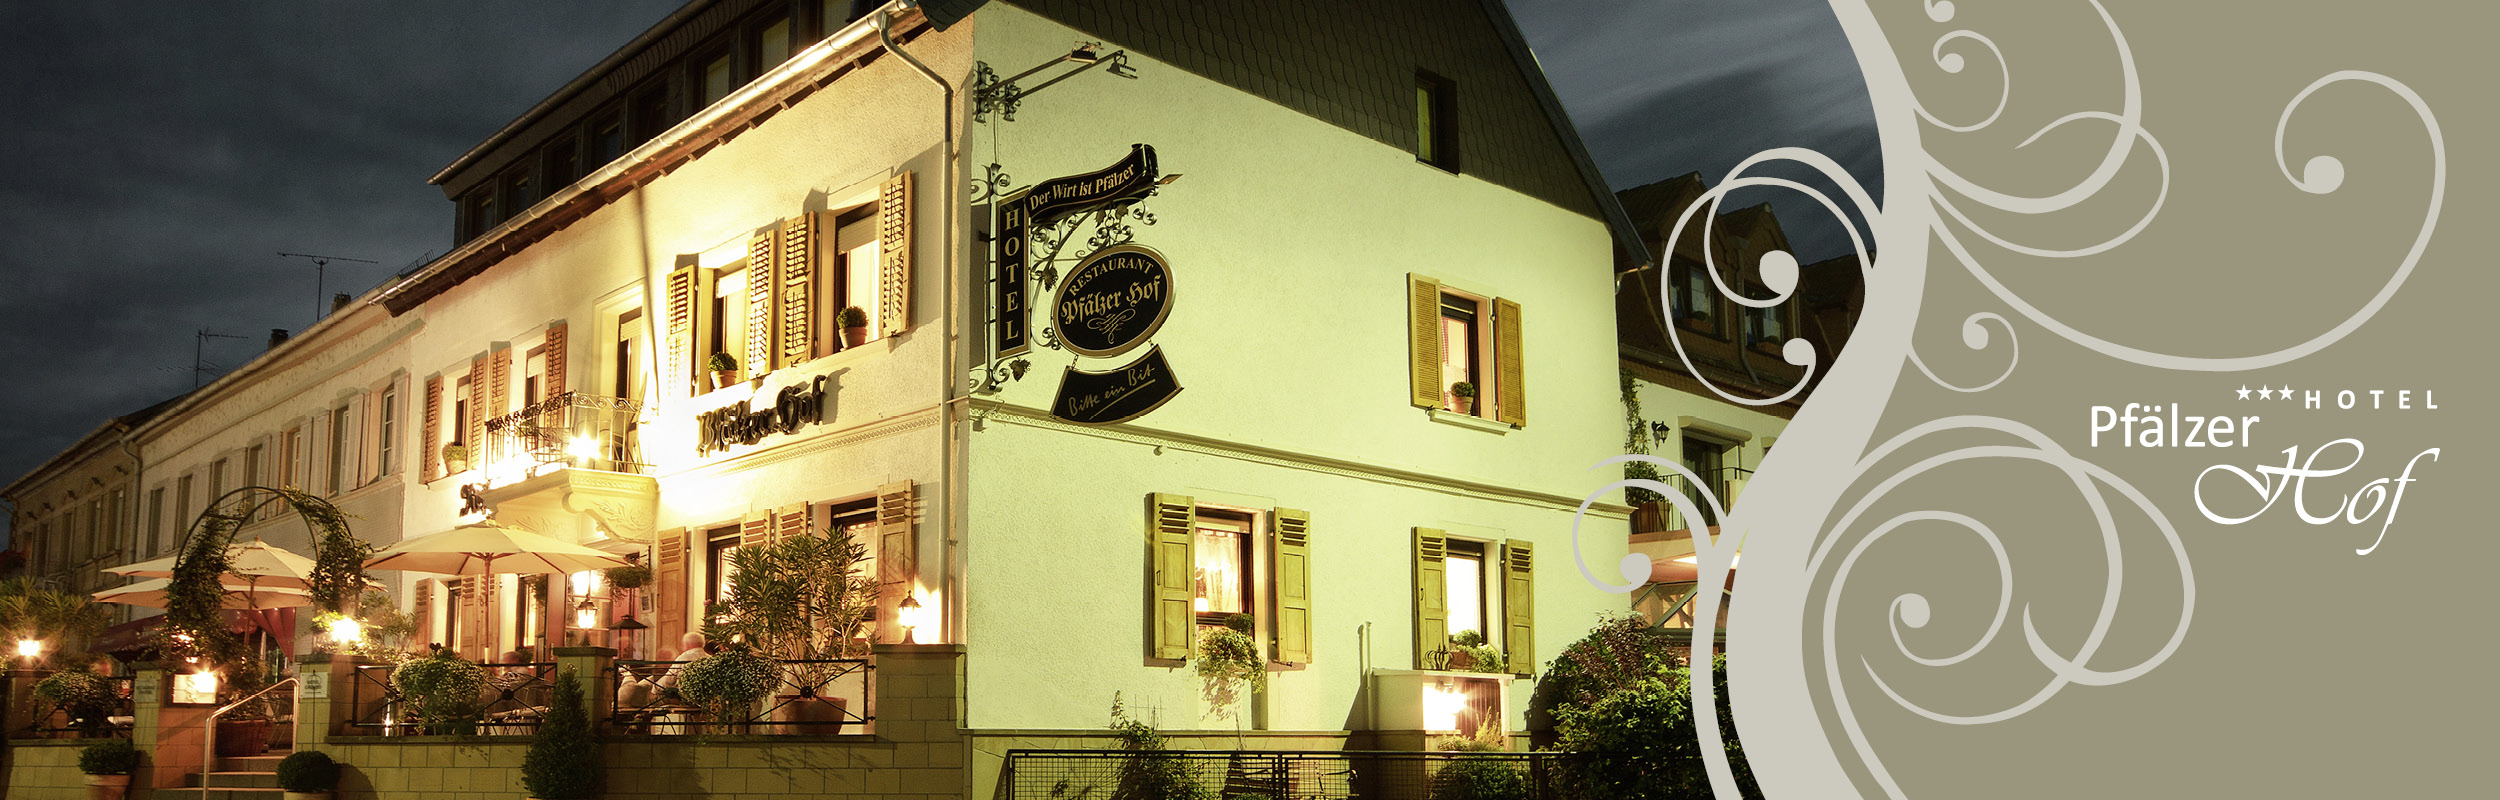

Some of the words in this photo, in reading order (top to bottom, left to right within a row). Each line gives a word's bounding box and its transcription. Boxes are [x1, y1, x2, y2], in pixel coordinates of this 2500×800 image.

[1030, 191, 1050, 210] Der
[1052, 184, 1077, 200] Wirt
[1079, 181, 1093, 196] ist
[1095, 164, 1135, 194] Pfälzer
[1004, 210, 1020, 341] HOTEL
[1061, 291, 1121, 325] Pfälzer
[1126, 274, 1161, 307] Hof
[1069, 257, 1154, 296] RESTAURANT
[1068, 394, 1100, 416] Bitte
[1104, 386, 1126, 399] ein
[1128, 363, 1155, 387] Bit
